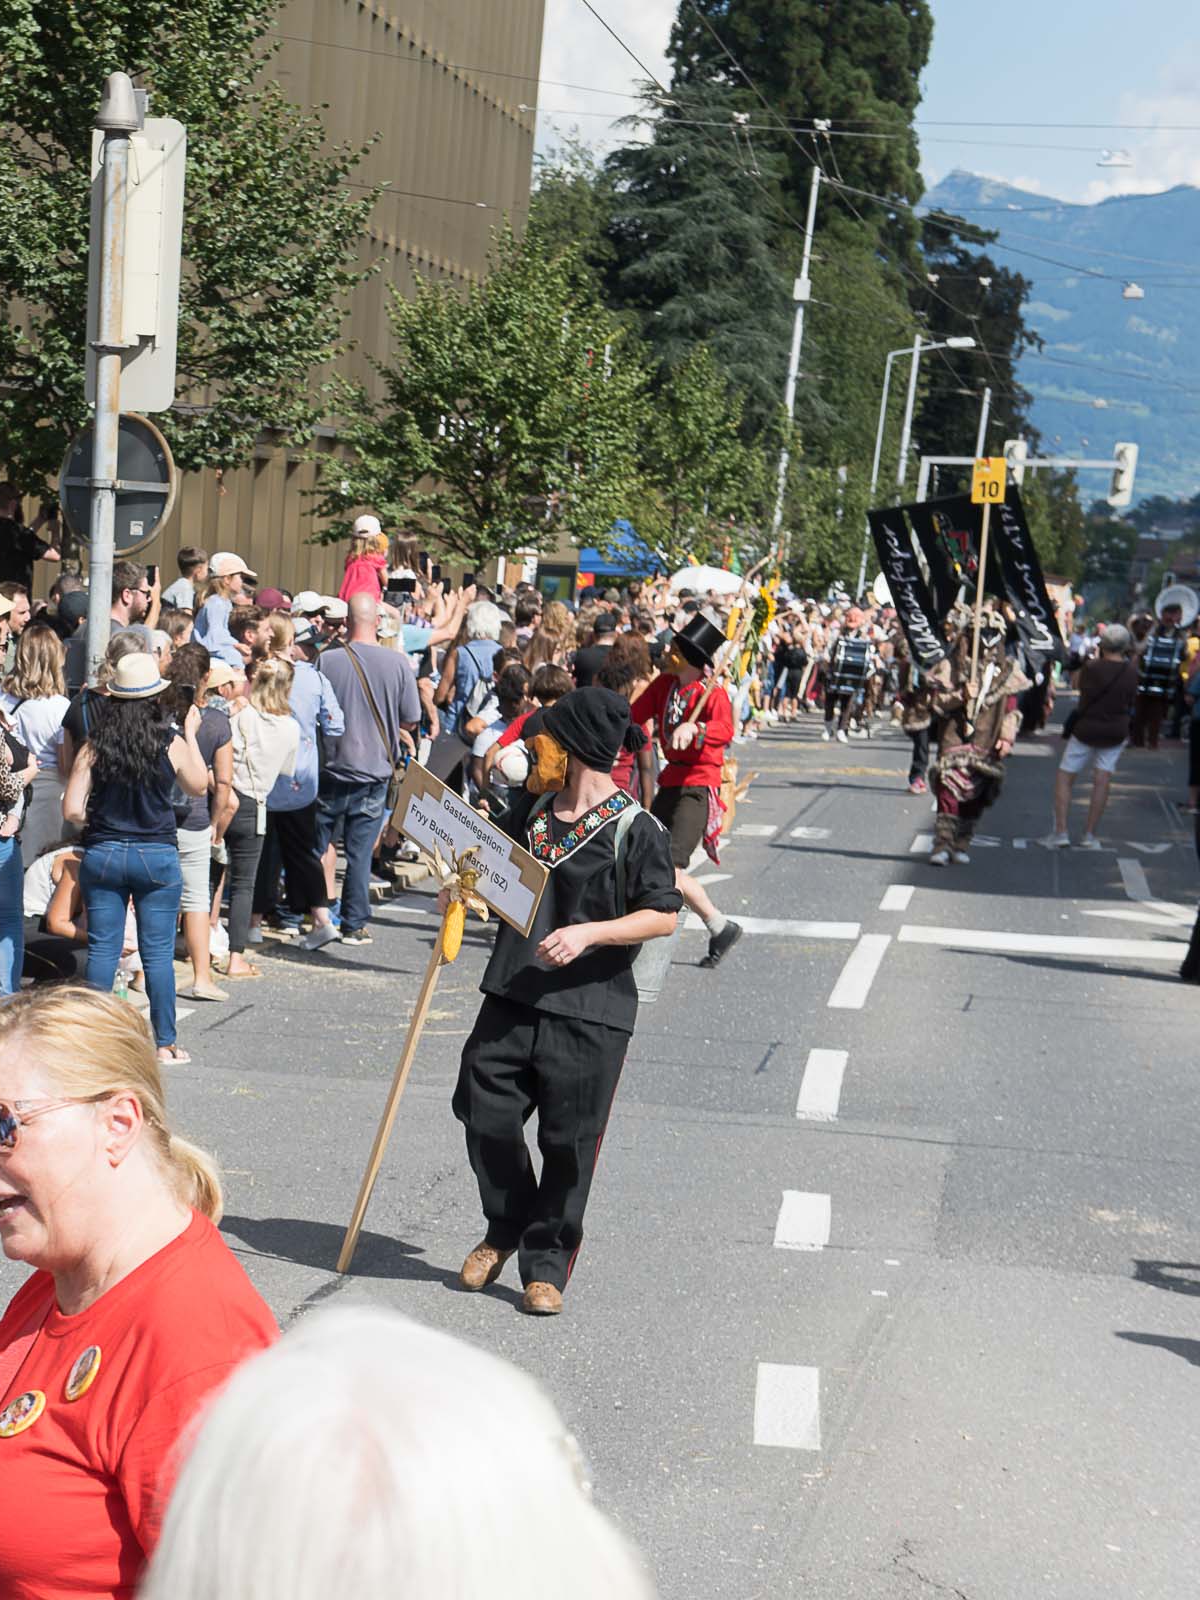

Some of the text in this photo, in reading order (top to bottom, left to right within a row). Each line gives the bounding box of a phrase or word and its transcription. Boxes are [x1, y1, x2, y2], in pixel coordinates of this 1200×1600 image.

[980, 480, 999, 498] 10
[411, 804, 429, 826] Fryy
[429, 819, 454, 846] Butzis
[490, 871, 508, 893] (SZ)
[444, 799, 504, 857] Gastdelegation:
